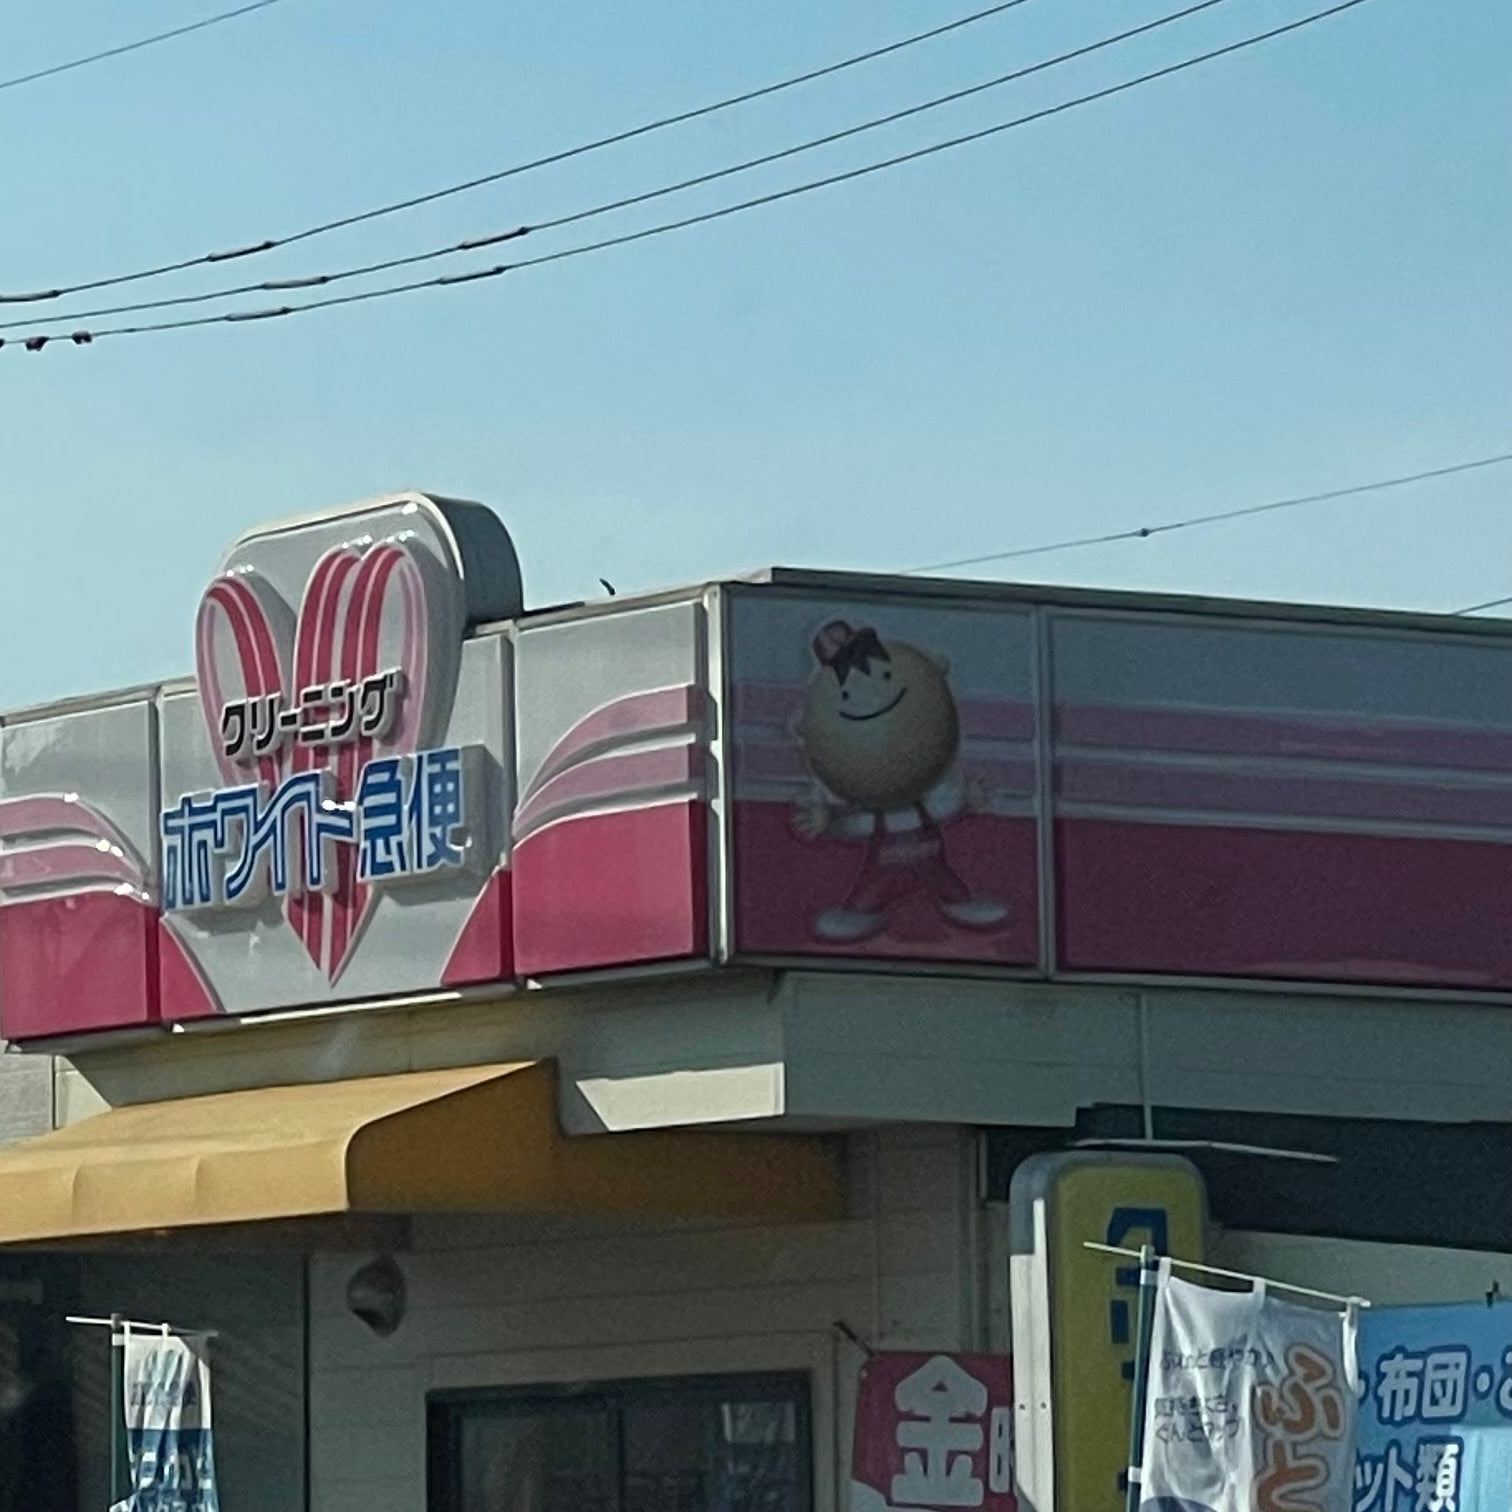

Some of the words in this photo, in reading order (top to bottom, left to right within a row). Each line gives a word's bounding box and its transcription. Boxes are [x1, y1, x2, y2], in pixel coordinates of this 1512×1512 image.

[220, 665, 402, 762] クリーニング
[160, 746, 470, 911] ホワイト急便
